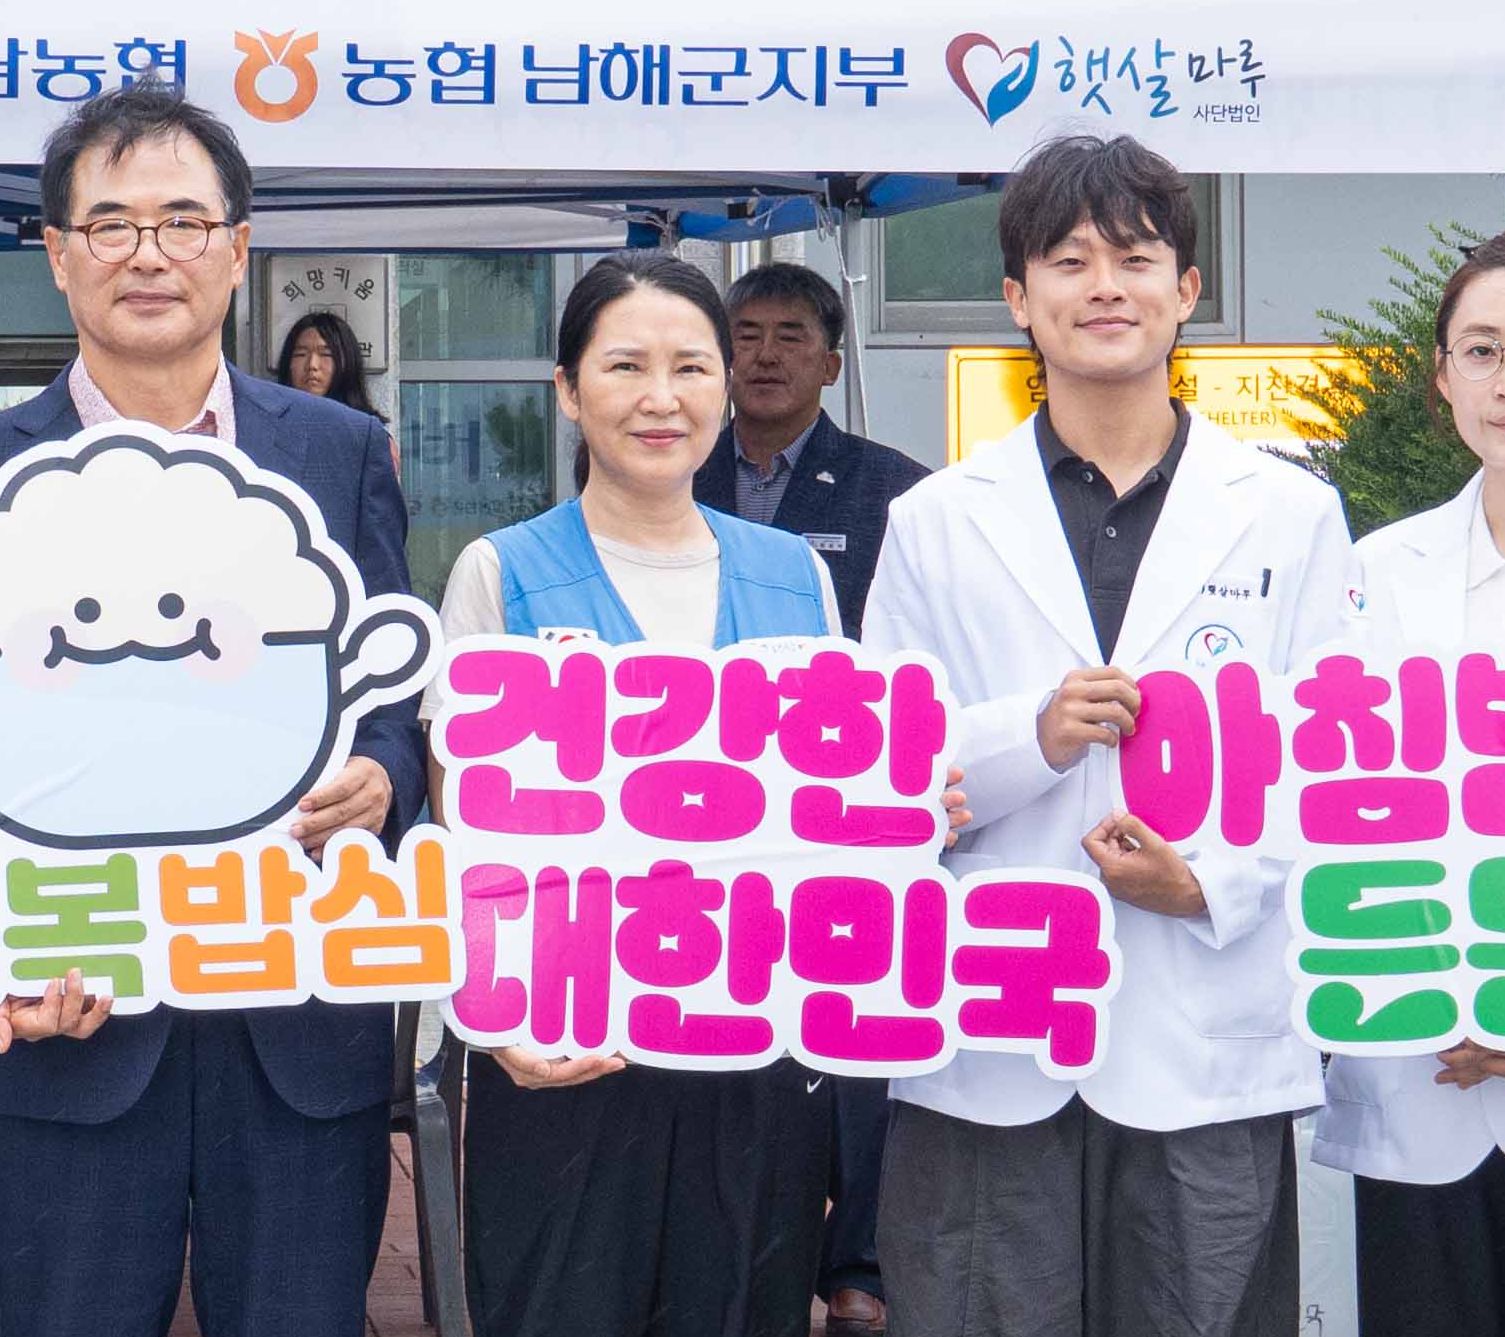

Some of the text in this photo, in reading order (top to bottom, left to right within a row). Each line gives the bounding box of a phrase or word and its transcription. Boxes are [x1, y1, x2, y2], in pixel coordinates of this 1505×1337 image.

[343, 42, 907, 107] 농협 남해군지부
[1193, 104, 1261, 123] 사단법인
[1200, 407, 1278, 427] HELTER)
[446, 651, 946, 847] 건강한
[453, 860, 1110, 1066] 대한민국
